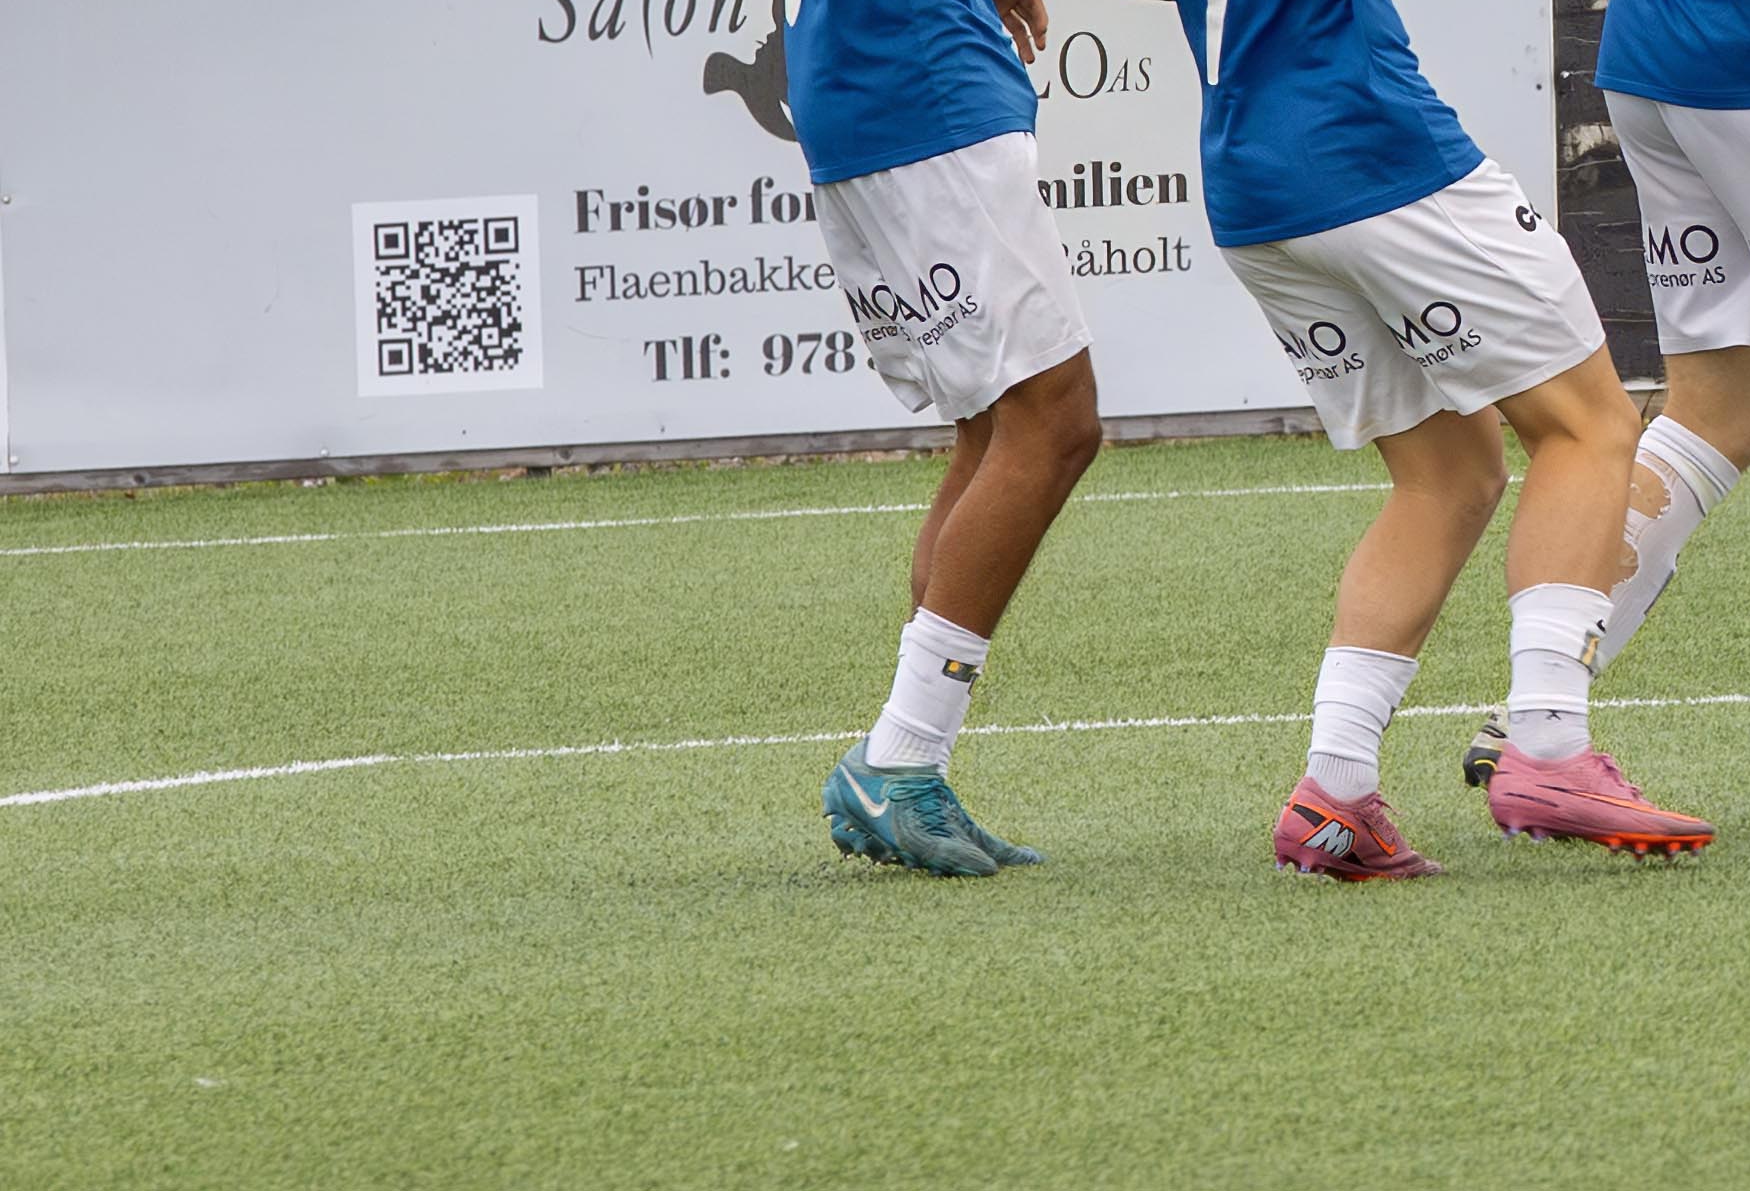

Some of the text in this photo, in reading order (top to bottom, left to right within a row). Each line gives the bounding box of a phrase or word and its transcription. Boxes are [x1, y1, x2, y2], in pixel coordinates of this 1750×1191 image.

[574, 185, 738, 233] Frisør
[1037, 161, 1190, 209] milien
[1646, 224, 1719, 265] MO
[574, 255, 838, 302] Flaenbakke
[1702, 266, 1726, 286] AS
[959, 295, 978, 319] AS
[1459, 327, 1482, 349] AS
[643, 333, 731, 382] Tlf:
[1342, 352, 1365, 373] AS
